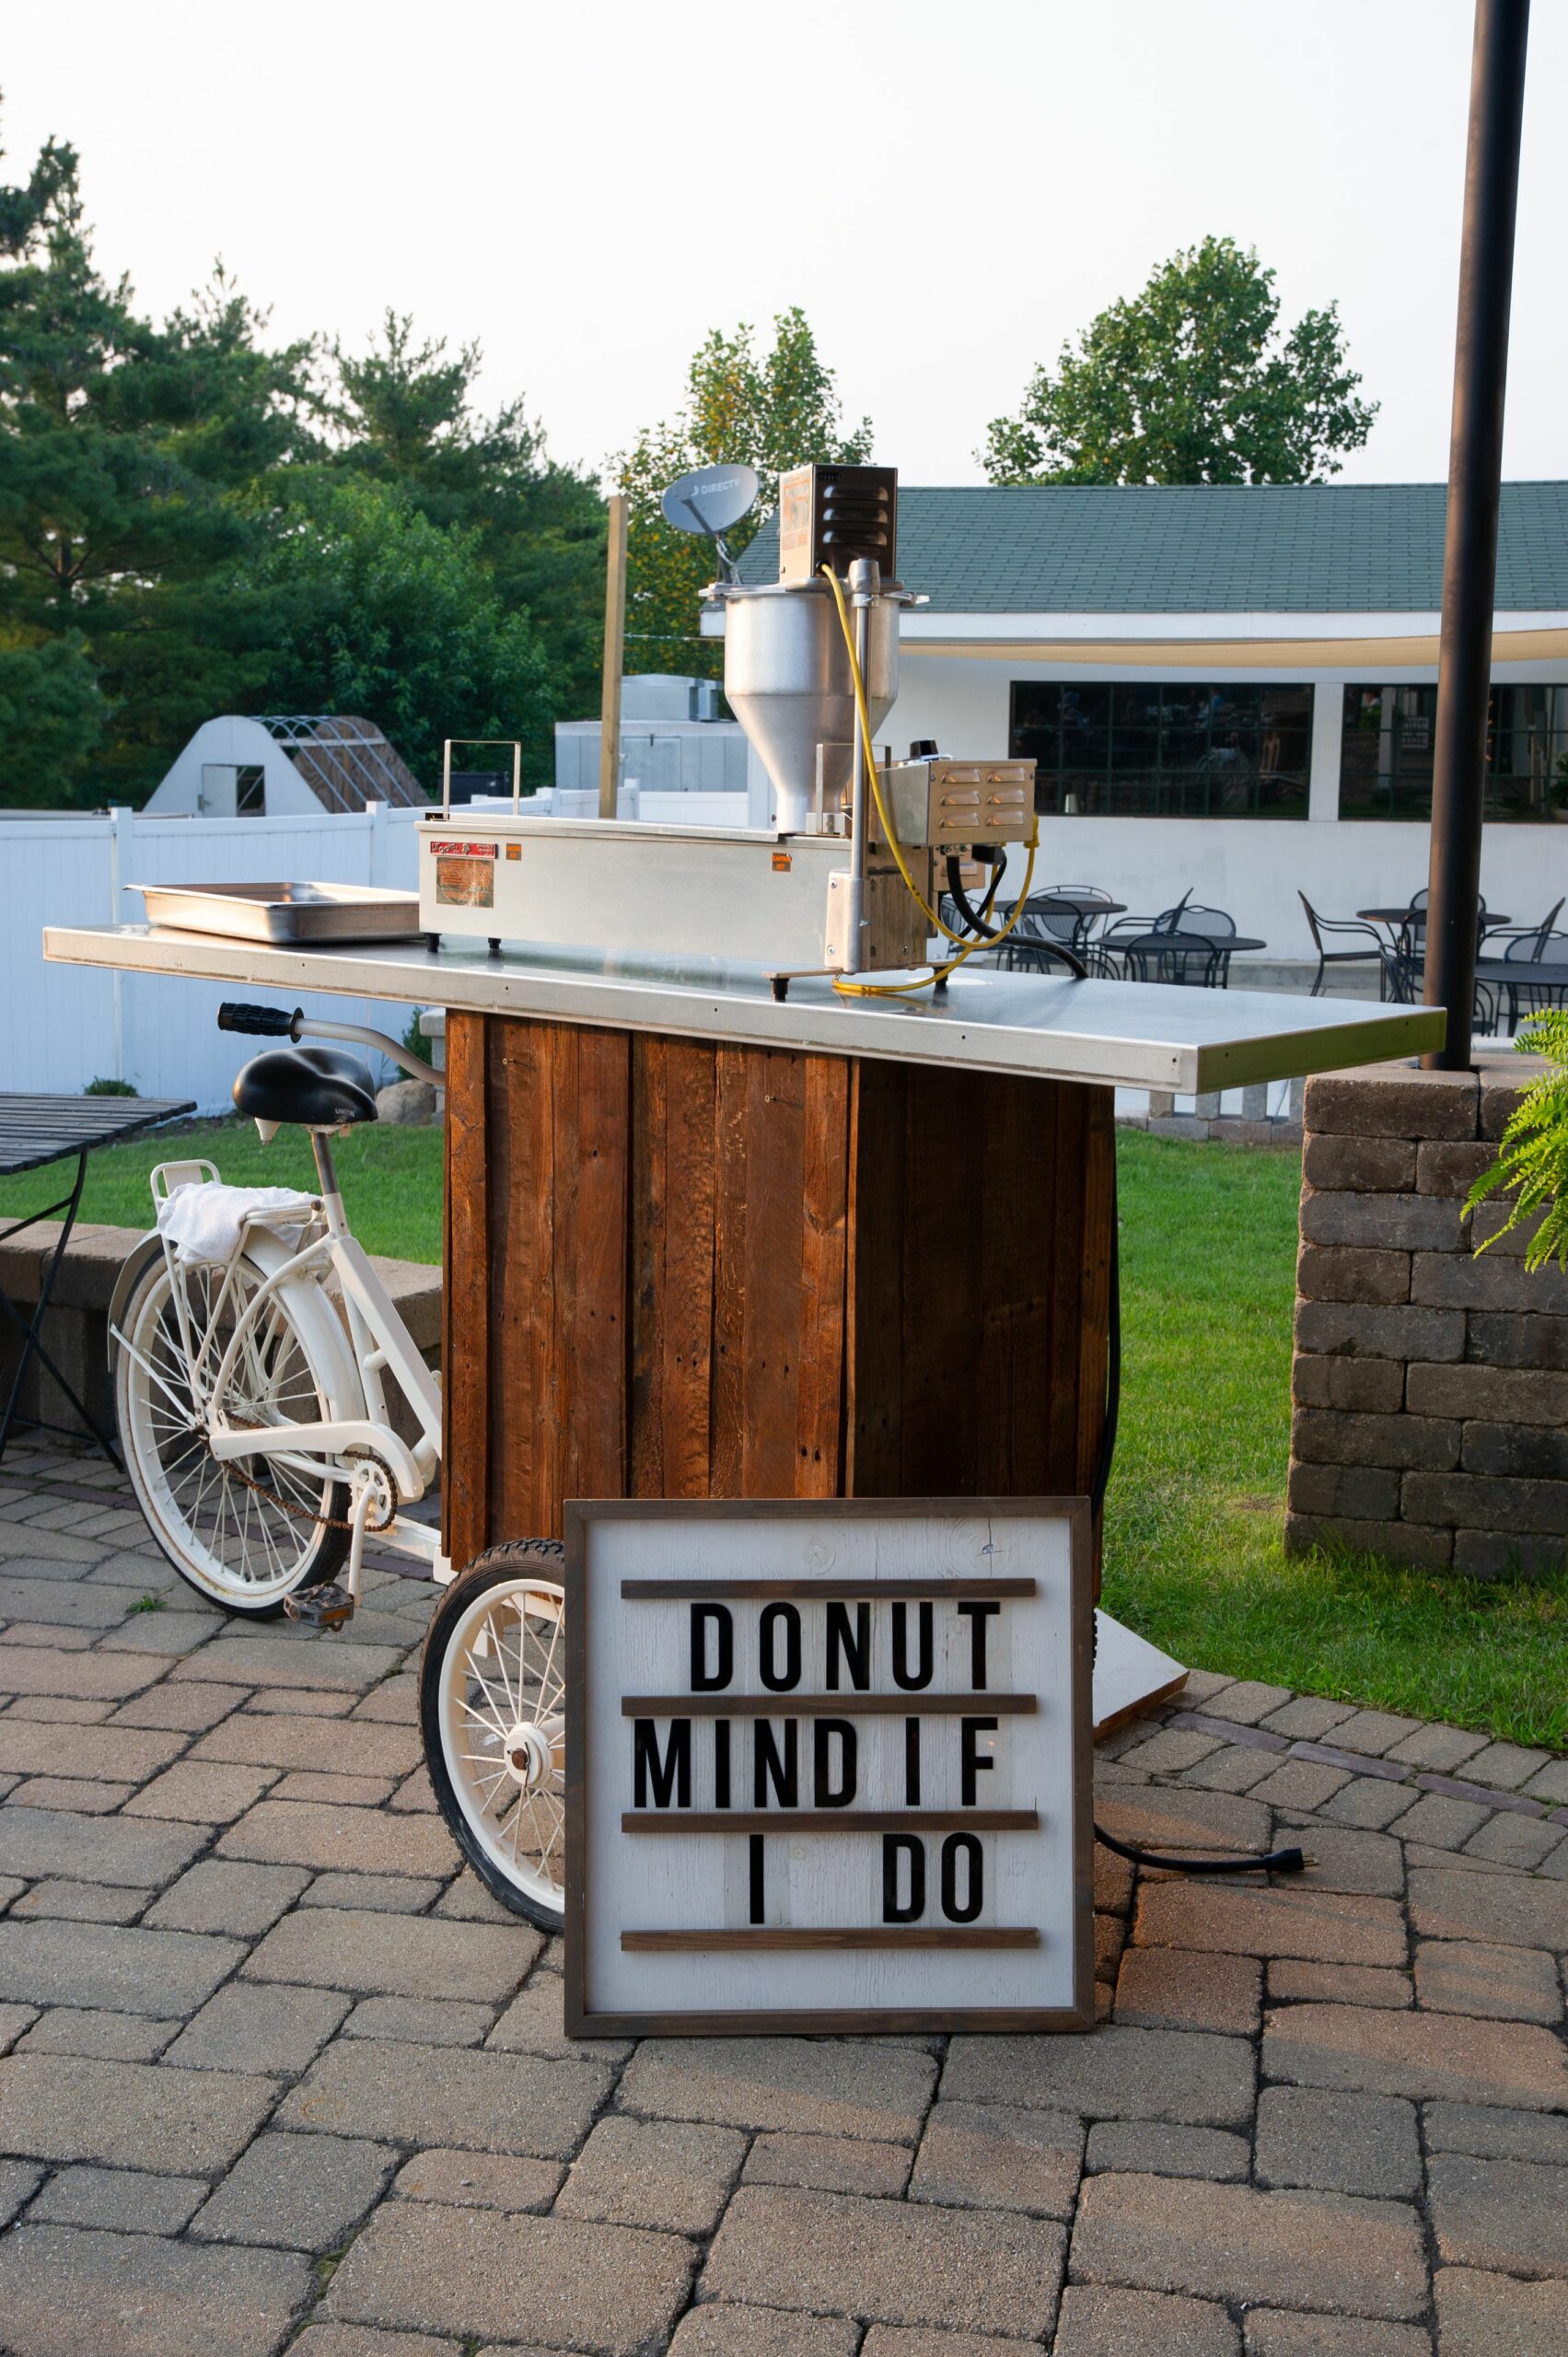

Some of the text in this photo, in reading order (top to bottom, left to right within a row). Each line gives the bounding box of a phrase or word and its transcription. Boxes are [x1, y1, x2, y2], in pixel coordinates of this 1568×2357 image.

[701, 478, 740, 494] DIRECTV
[334, 1108, 355, 1118] UNION
[690, 1602, 1001, 1692] DONUT
[633, 1716, 999, 1809] MIND IF
[749, 1831, 983, 1924] I DO
